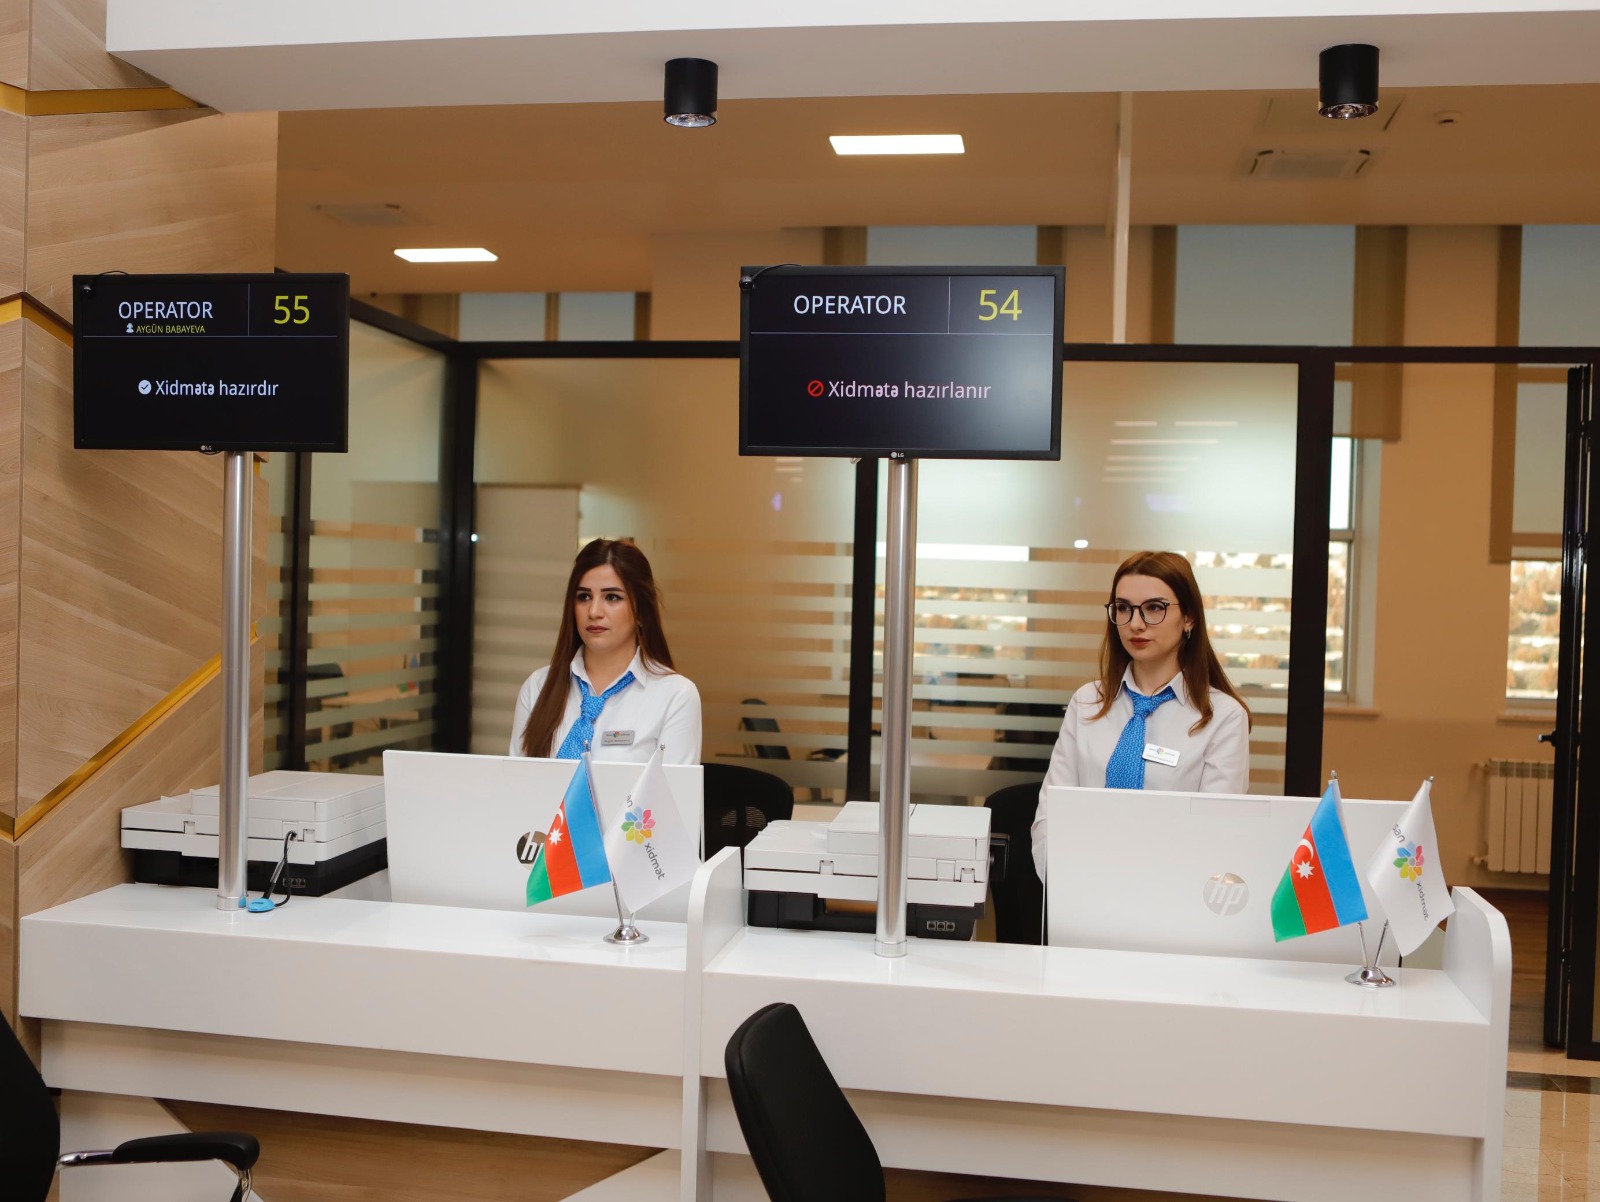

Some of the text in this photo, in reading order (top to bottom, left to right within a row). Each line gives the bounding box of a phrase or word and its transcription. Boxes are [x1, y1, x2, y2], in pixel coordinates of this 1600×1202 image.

[118, 301, 213, 319] OPERATOR
[273, 295, 310, 325] 55
[793, 295, 907, 315] OPERATOR
[978, 289, 1022, 321] 54
[135, 324, 206, 334] AYGÜN BABAYEVA
[155, 380, 279, 397] Xidmətə hazırdır
[828, 380, 992, 399] Xidmətə hazırlanır
[1391, 823, 1406, 843] san
[644, 842, 665, 880] xidmət
[1205, 873, 1246, 915] hp
